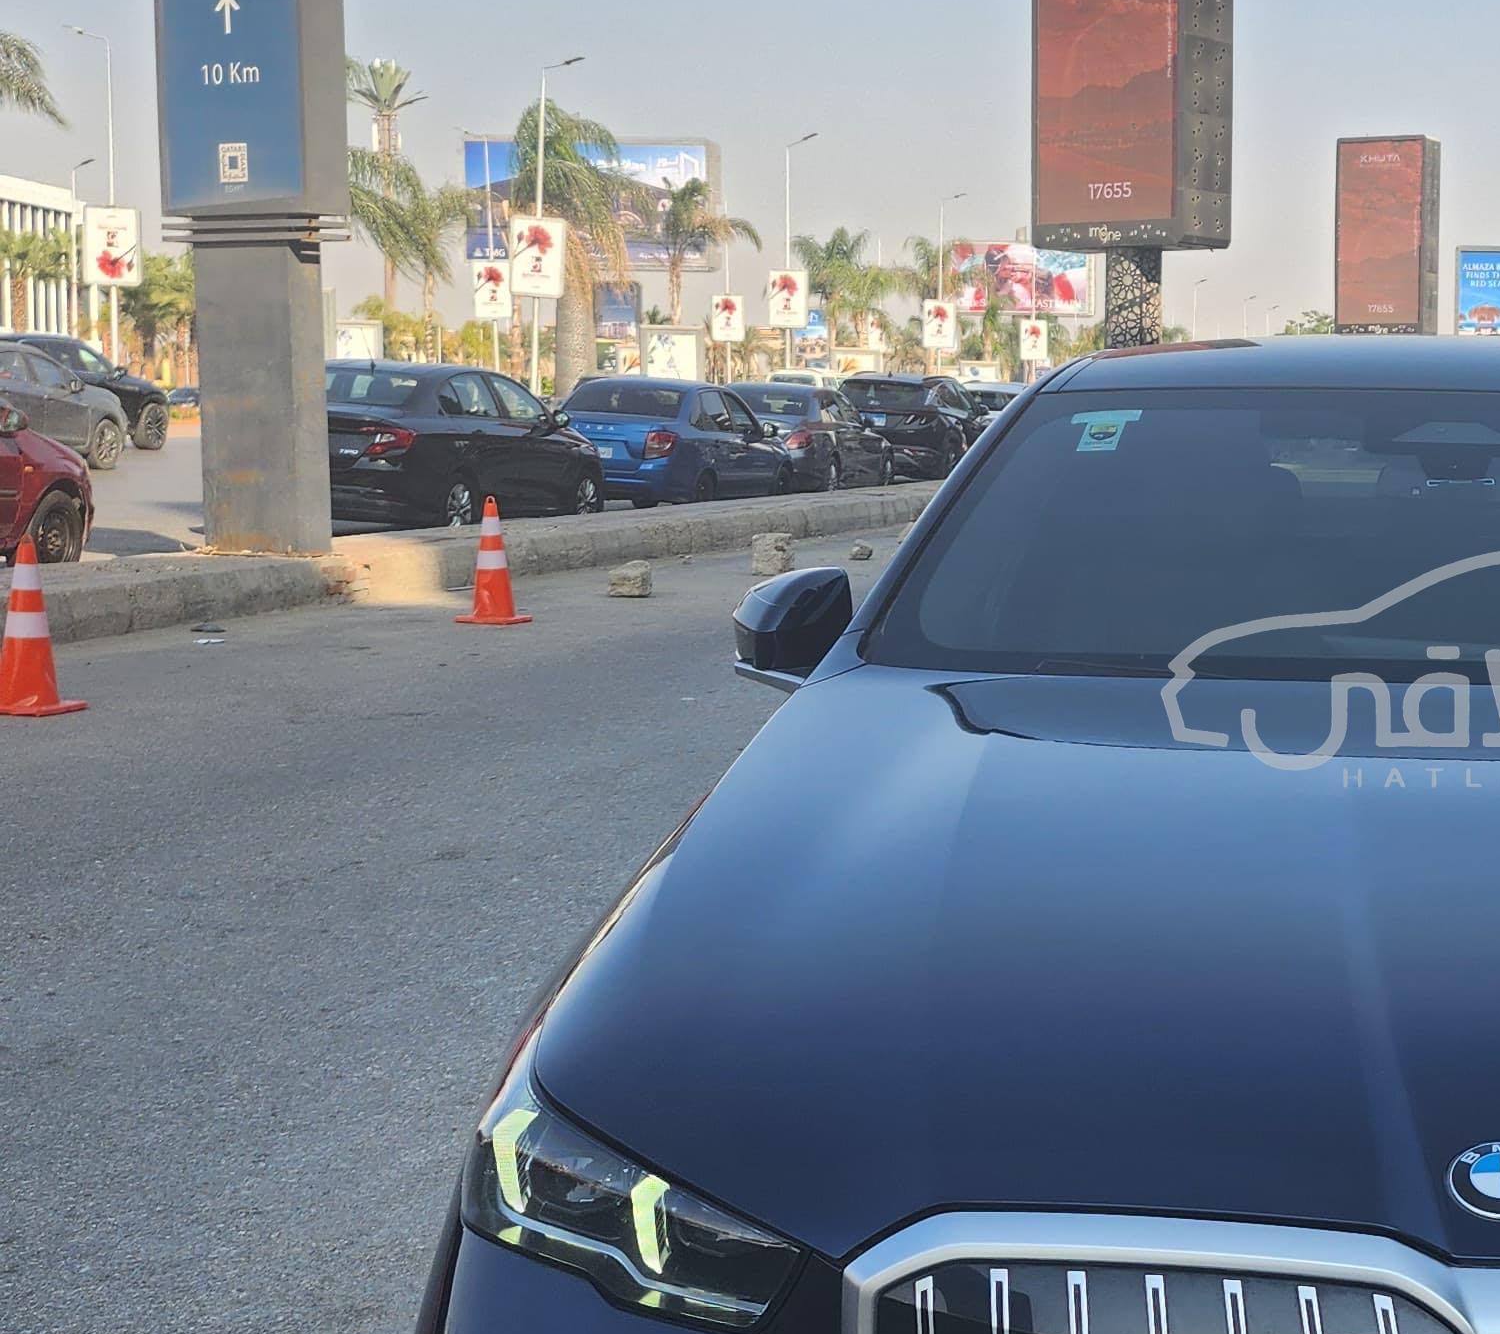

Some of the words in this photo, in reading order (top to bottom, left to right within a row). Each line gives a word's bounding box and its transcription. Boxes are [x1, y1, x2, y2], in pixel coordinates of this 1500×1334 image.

[201, 63, 223, 85] 10
[229, 62, 260, 84] Km
[1088, 182, 1132, 200] 17655
[1463, 263, 1494, 271] ALMAZA
[1470, 280, 1487, 288] RED
